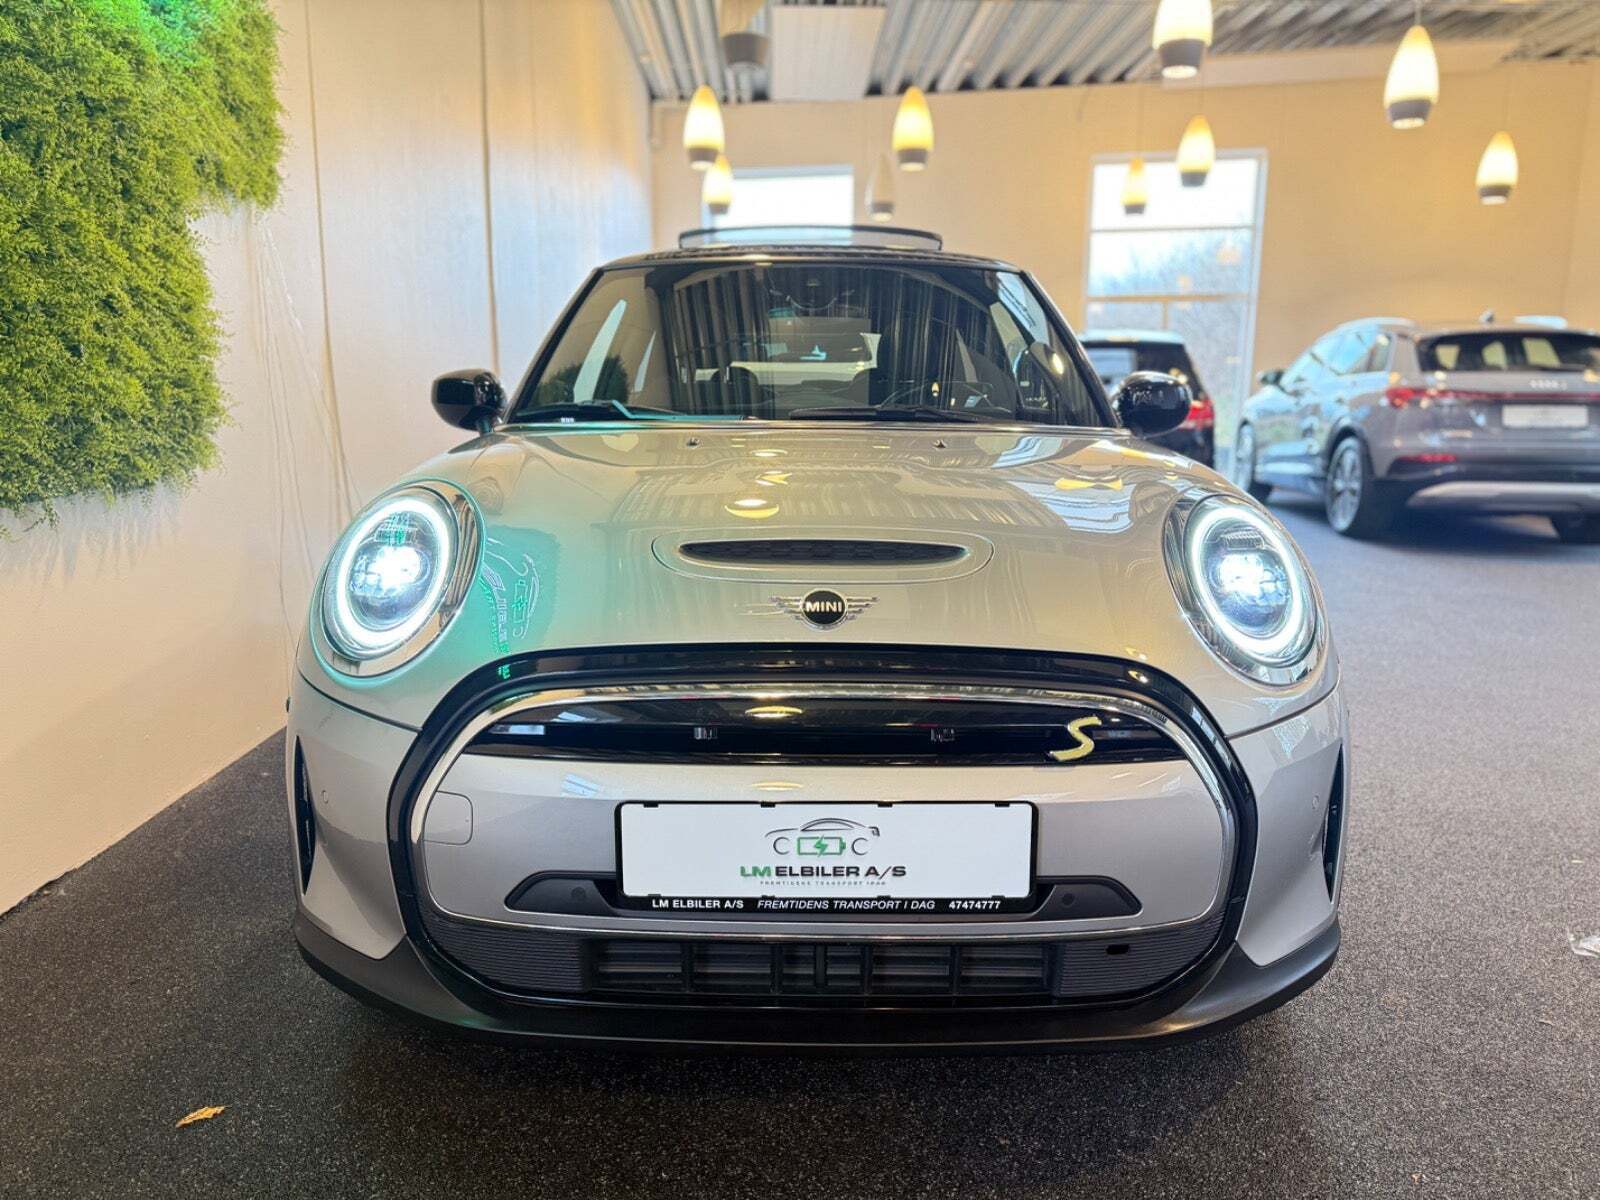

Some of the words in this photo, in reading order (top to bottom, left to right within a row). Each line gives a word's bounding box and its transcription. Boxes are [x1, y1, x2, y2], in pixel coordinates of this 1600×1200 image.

[805, 601, 842, 613] MINI
[1049, 715, 1102, 761] S
[740, 866, 771, 877] LM
[775, 866, 860, 877] ELBILER
[865, 866, 907, 879] A/S
[651, 900, 669, 909] LM
[672, 900, 721, 909] ELBILER
[724, 900, 744, 909] A/S
[757, 901, 829, 910] FREMTIDENS
[833, 901, 900, 910] TRANSPORT
[903, 901, 908, 910] I
[911, 901, 936, 910] DAG
[949, 901, 1000, 909] 47474777
